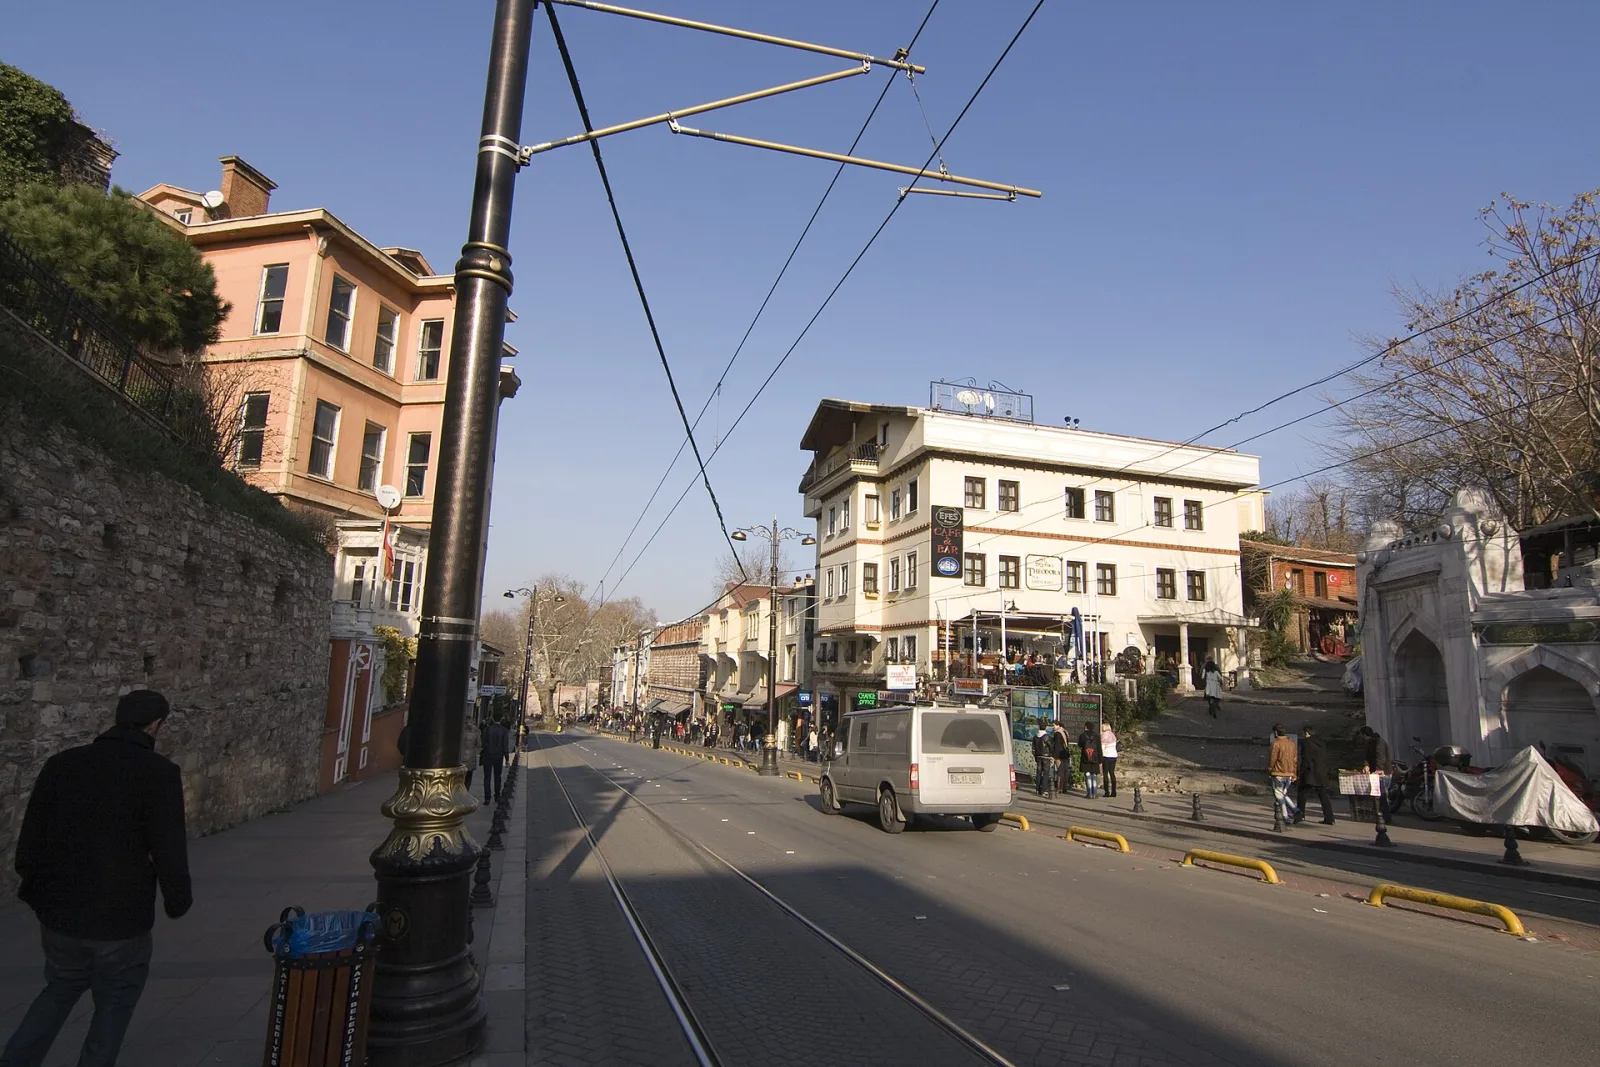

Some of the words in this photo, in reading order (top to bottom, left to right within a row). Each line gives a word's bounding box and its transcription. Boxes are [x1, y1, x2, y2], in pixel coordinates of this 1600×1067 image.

[939, 511, 959, 521] EFES
[933, 527, 962, 538] CAFE
[937, 544, 958, 555] BAR
